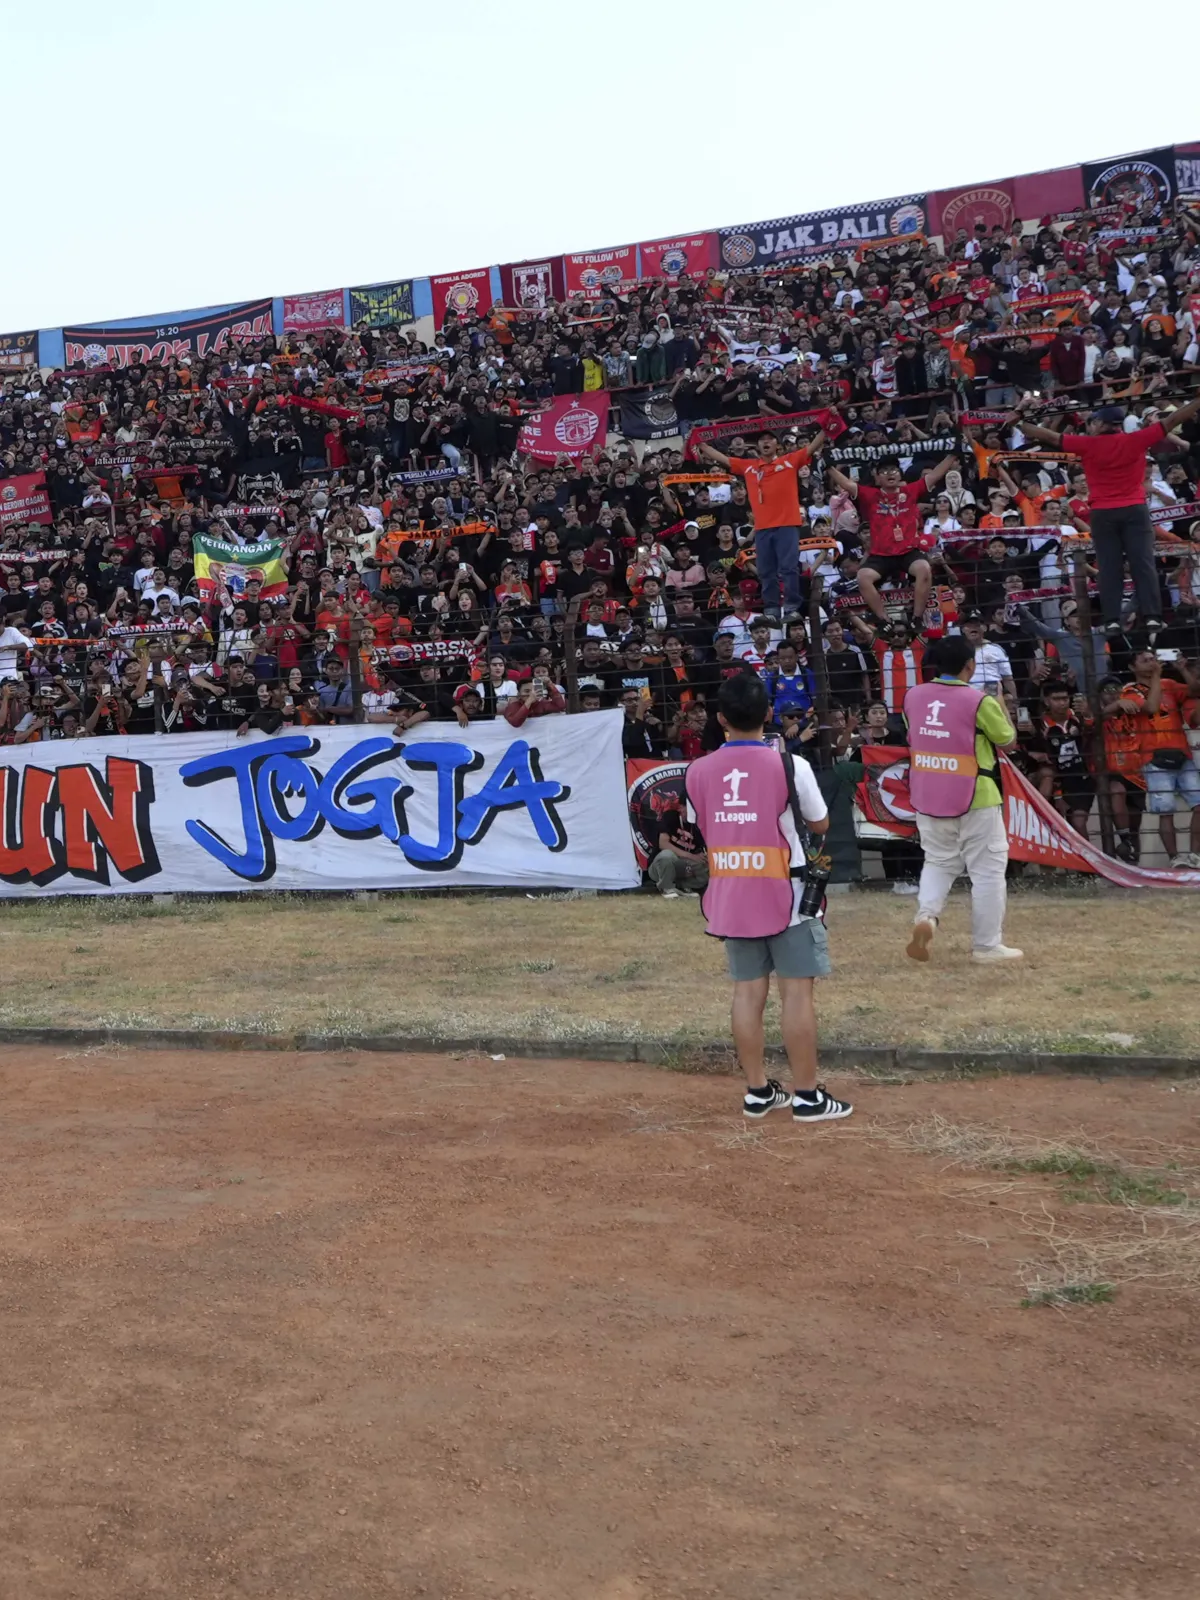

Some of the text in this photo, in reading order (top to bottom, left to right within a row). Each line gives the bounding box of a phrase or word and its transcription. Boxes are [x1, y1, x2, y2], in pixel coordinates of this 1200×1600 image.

[759, 226, 815, 255] JAK
[821, 214, 888, 244] BALI
[659, 241, 686, 251] FOLLOW
[571, 248, 629, 264] WE FOLLOW YOU
[434, 271, 486, 284] PERSIJA ADORED
[156, 326, 180, 338] JS.20
[18, 335, 35, 346] 67
[664, 427, 679, 437] TOU
[404, 468, 455, 480] PERSIJA JAKARTA
[247, 506, 280, 515] JAKARTA
[408, 527, 465, 539] JAKMIA
[144, 622, 189, 633] JAKARTA
[915, 754, 958, 771] PHOTO
[642, 768, 681, 790] JAK MANIA
[179, 735, 571, 883] JOGJA
[1008, 837, 1067, 860] KORWIL
